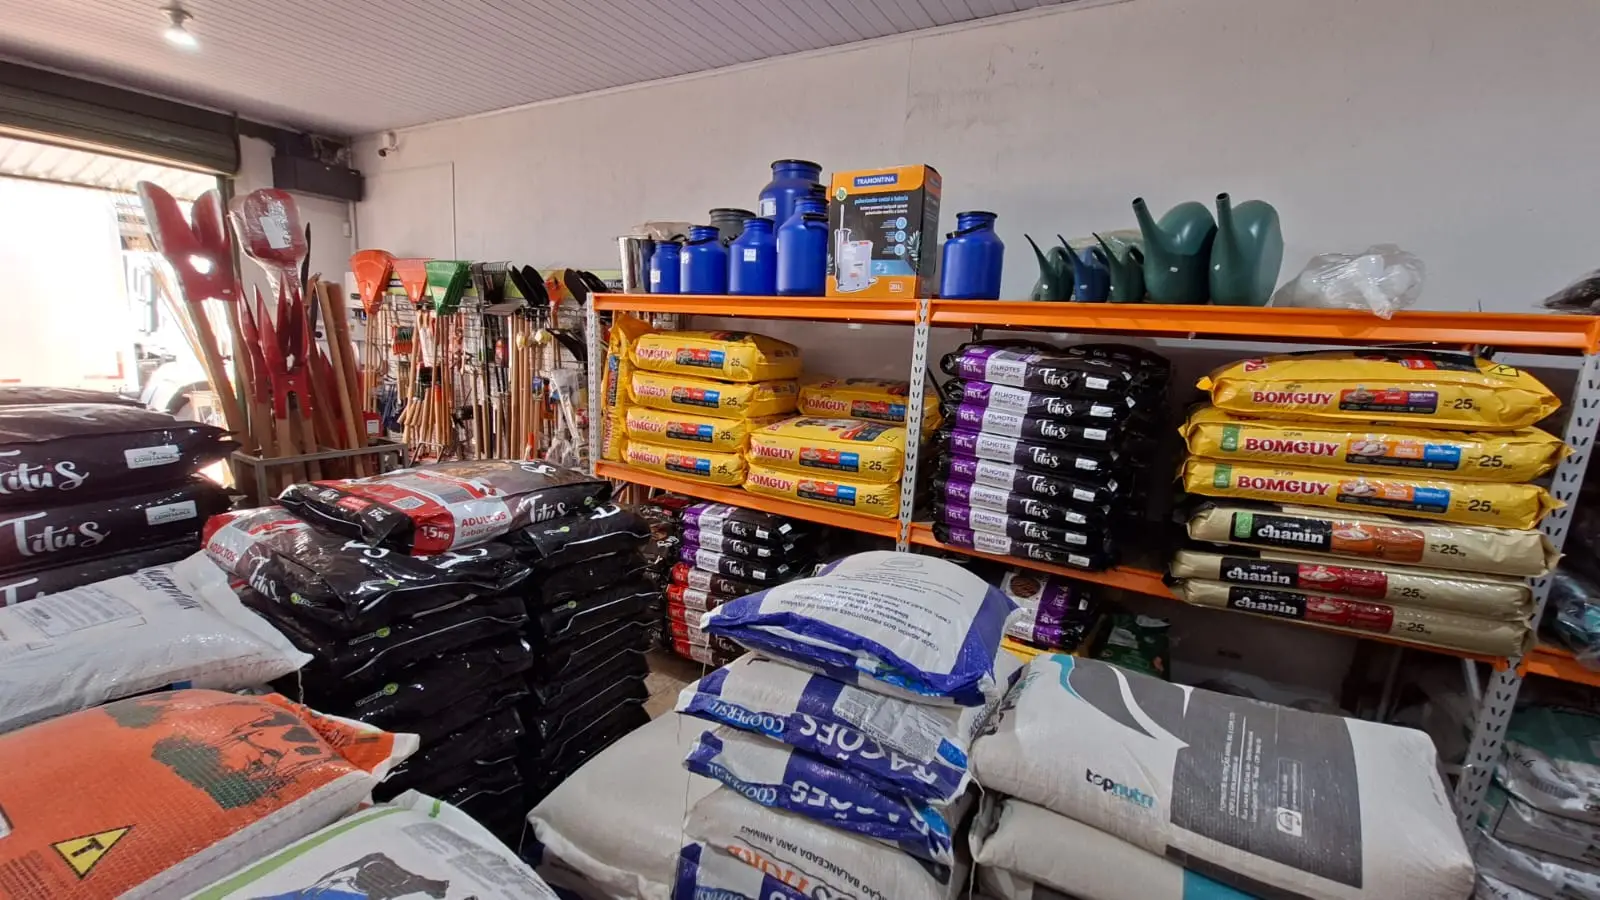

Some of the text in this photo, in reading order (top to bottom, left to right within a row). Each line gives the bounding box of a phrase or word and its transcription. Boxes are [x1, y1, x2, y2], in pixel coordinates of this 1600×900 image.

[857, 175, 895, 185] TRAMONTINA
[1038, 367, 1072, 389] Titus
[1043, 397, 1076, 417] Titus
[1252, 391, 1334, 405] BOMGUY
[1453, 398, 1473, 410] 25
[1036, 419, 1069, 440] Titus
[1244, 437, 1340, 456] BOMGUY
[868, 460, 882, 471] 25
[1028, 446, 1061, 468] Titus
[1479, 455, 1503, 468] 25
[1026, 474, 1059, 497] Titus
[1236, 475, 1331, 496] BOMGUY
[865, 493, 879, 505] 25
[1467, 499, 1491, 513] 25
[1020, 498, 1050, 520] Titus
[0, 511, 111, 557] Titus
[1019, 520, 1051, 541] Titus
[1257, 524, 1324, 544] chanin
[1022, 542, 1055, 561] Titus
[1440, 543, 1458, 555] 25
[1226, 566, 1291, 585] chanin
[1402, 586, 1420, 598] 25
[1234, 596, 1298, 615] chanin
[1407, 622, 1424, 633] 25
[710, 701, 785, 733] COOPERSIL
[1086, 767, 1154, 808] topnutri
[789, 780, 930, 837] RÕES
[741, 824, 774, 845] ANIMAIS
[776, 837, 799, 855] PARA
[800, 848, 860, 888] BALANCEADA
